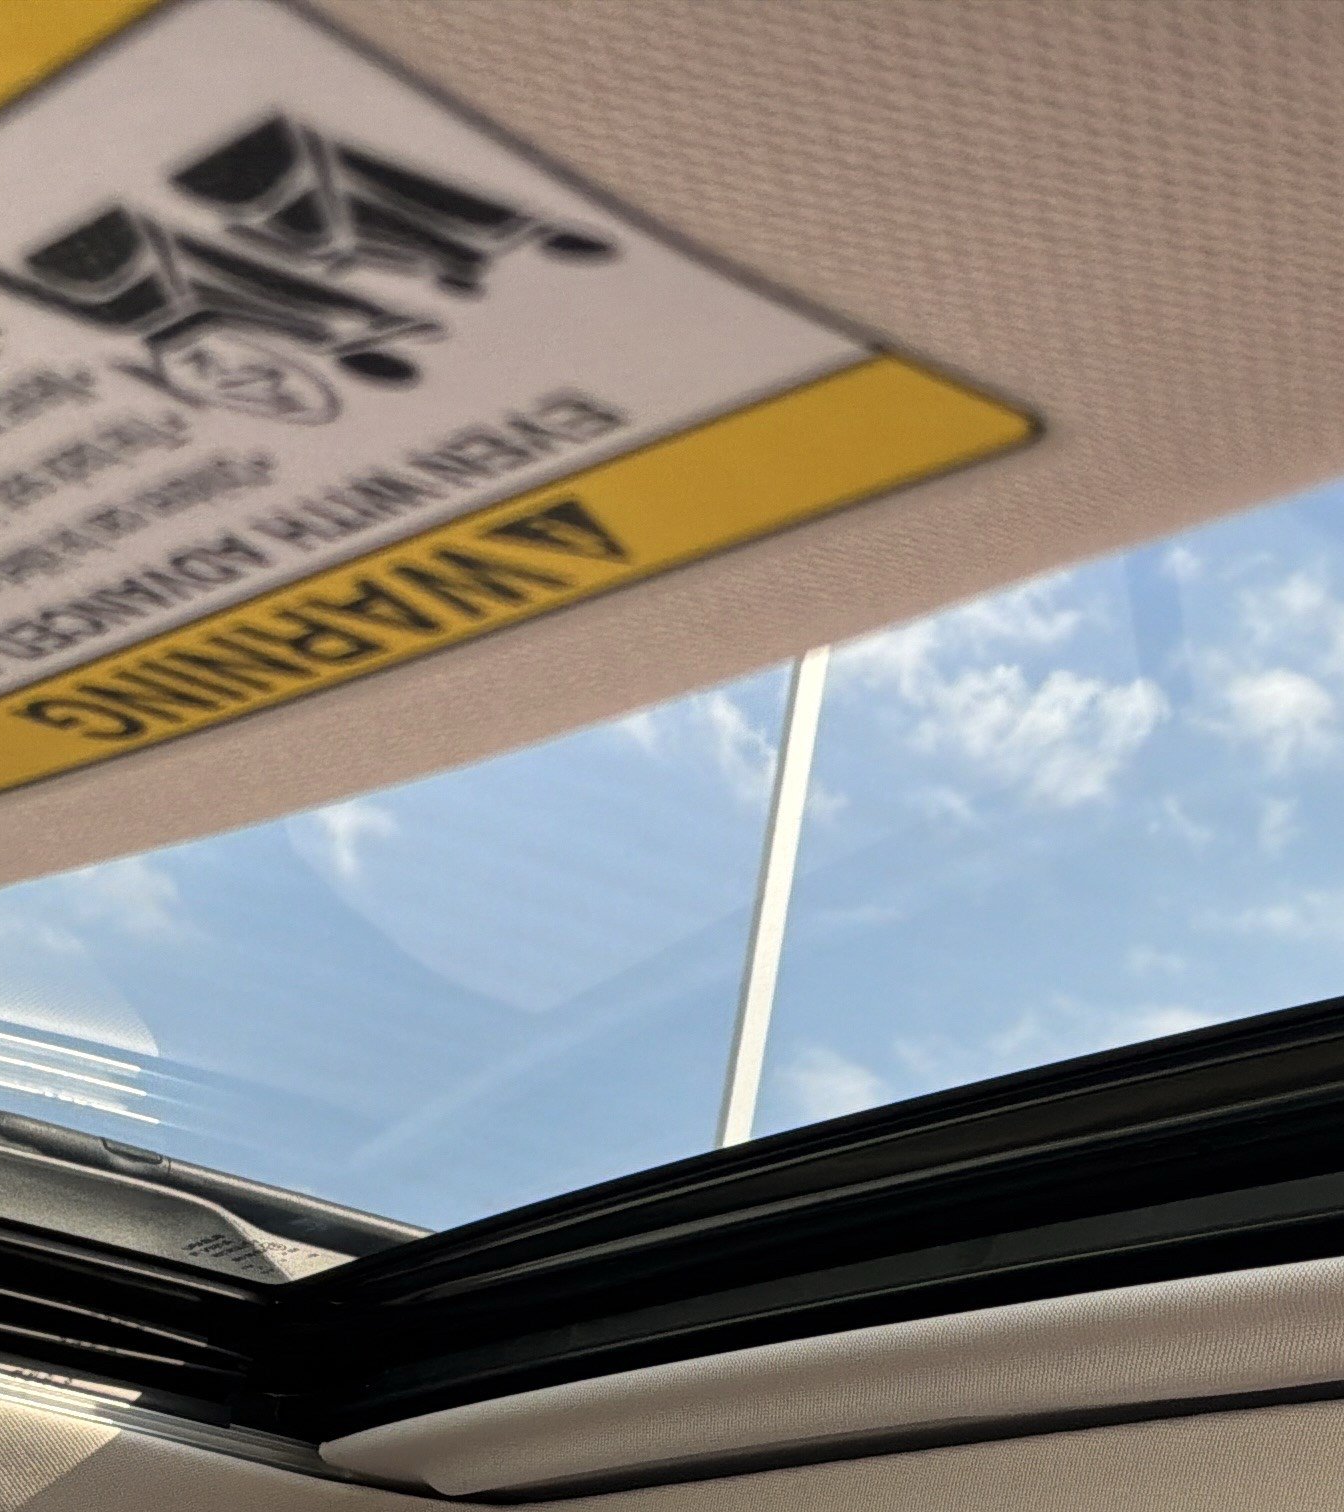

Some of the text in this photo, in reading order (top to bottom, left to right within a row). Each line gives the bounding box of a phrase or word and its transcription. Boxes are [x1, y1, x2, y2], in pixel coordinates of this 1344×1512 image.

[395, 386, 645, 492] EVEN
[244, 468, 446, 552] WITH
[4, 536, 587, 751] WARNING
